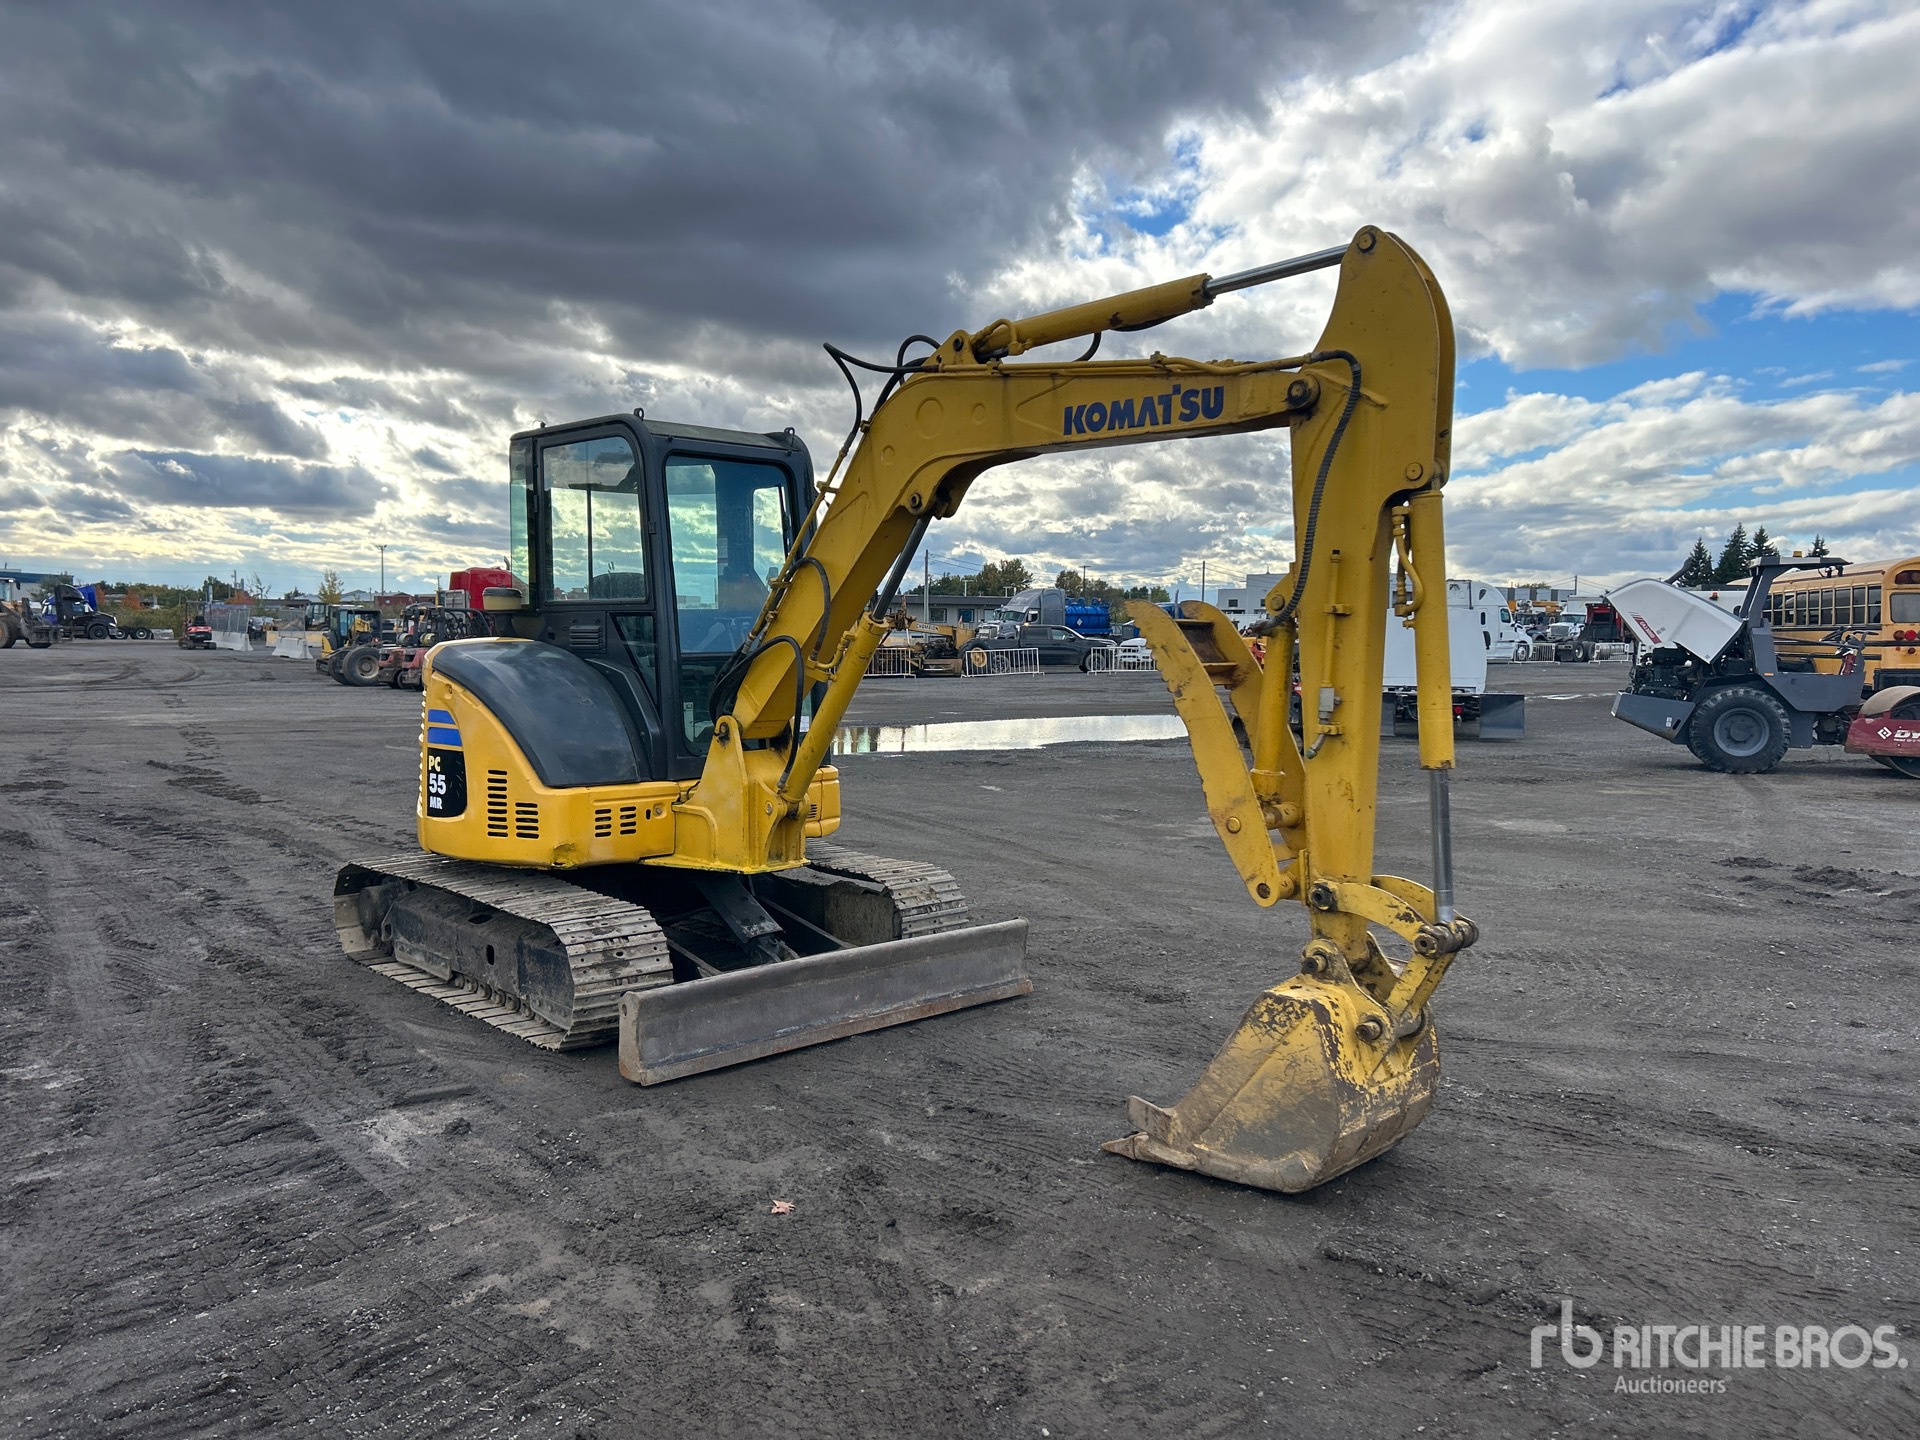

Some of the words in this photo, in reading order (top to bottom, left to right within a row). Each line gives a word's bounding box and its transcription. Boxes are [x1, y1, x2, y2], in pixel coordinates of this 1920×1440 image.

[1062, 383, 1225, 436] KOMATSU
[428, 755, 441, 772] PC
[428, 773, 447, 795] 55
[429, 796, 443, 810] MR
